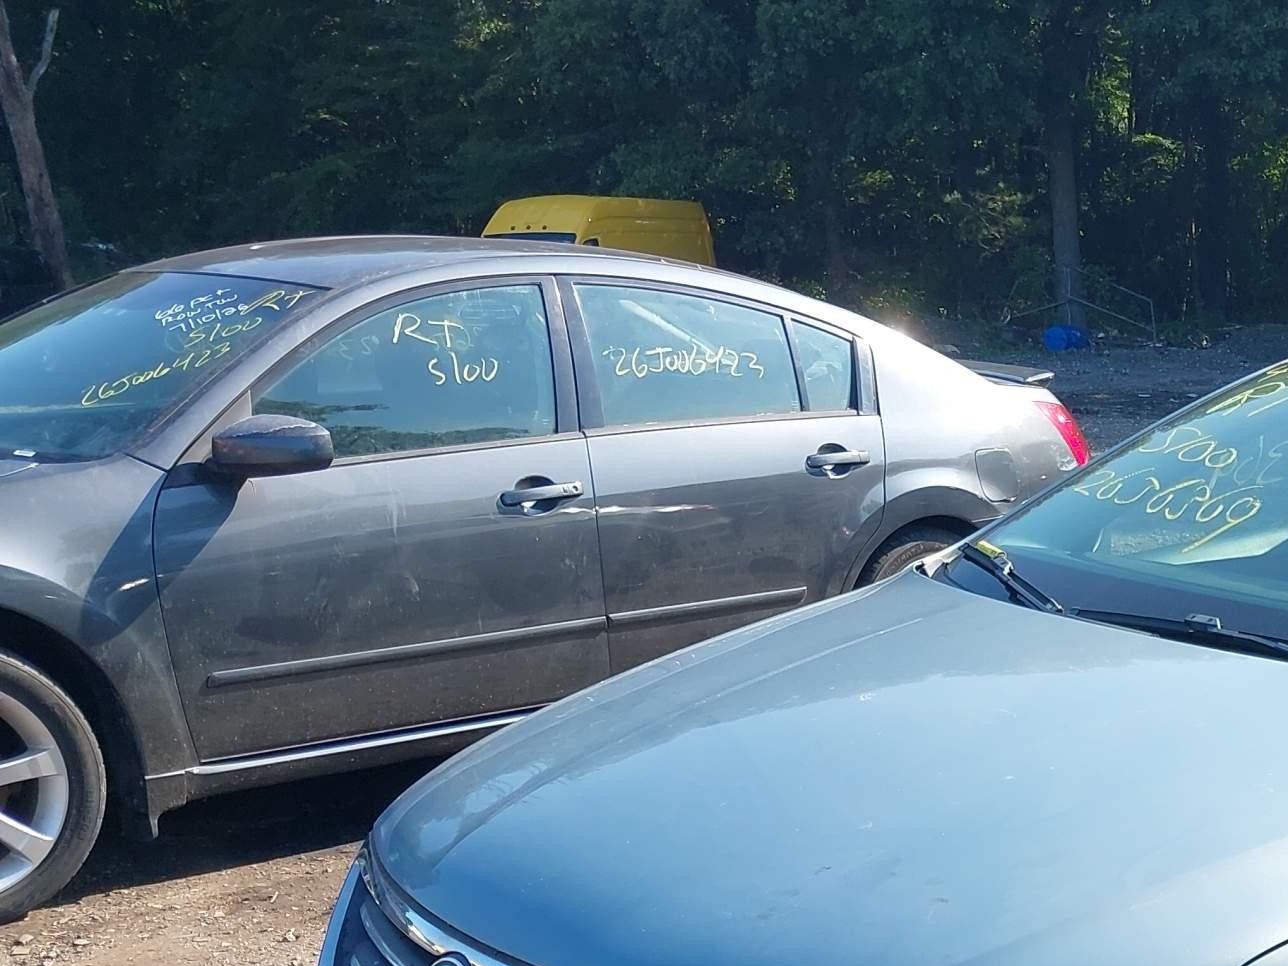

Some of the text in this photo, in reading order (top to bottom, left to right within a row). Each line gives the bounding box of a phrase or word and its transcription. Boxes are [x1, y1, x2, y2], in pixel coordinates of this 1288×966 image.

[392, 312, 465, 348] RT
[428, 351, 499, 386] S100
[1138, 426, 1238, 468] S100
